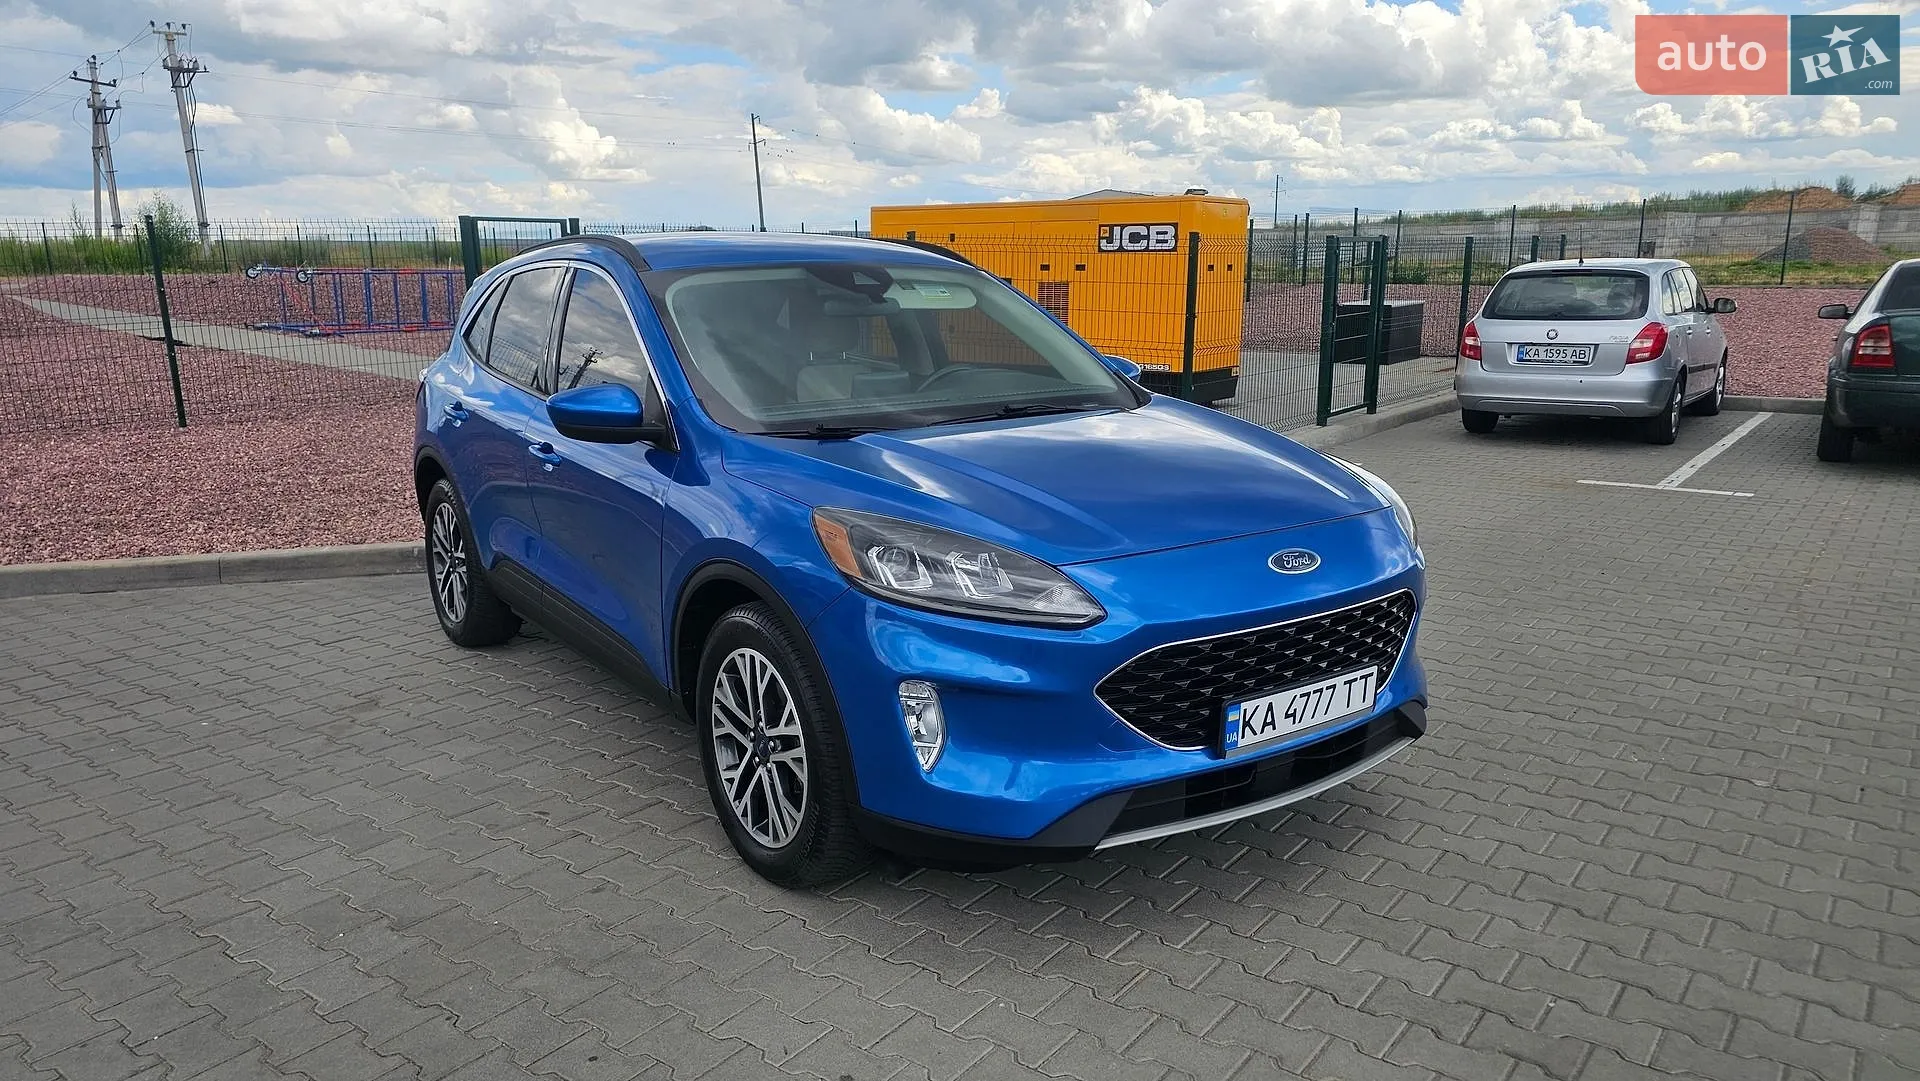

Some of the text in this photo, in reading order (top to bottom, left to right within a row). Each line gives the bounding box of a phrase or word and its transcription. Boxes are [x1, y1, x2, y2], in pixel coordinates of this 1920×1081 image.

[1100, 225, 1176, 250] JCB
[1524, 348, 1540, 358] KA
[1544, 348, 1568, 359] 1595
[1570, 349, 1587, 359] AB
[1282, 552, 1312, 568] Ford
[1241, 671, 1375, 739] KA 4777 TT
[1226, 732, 1238, 743] UA
